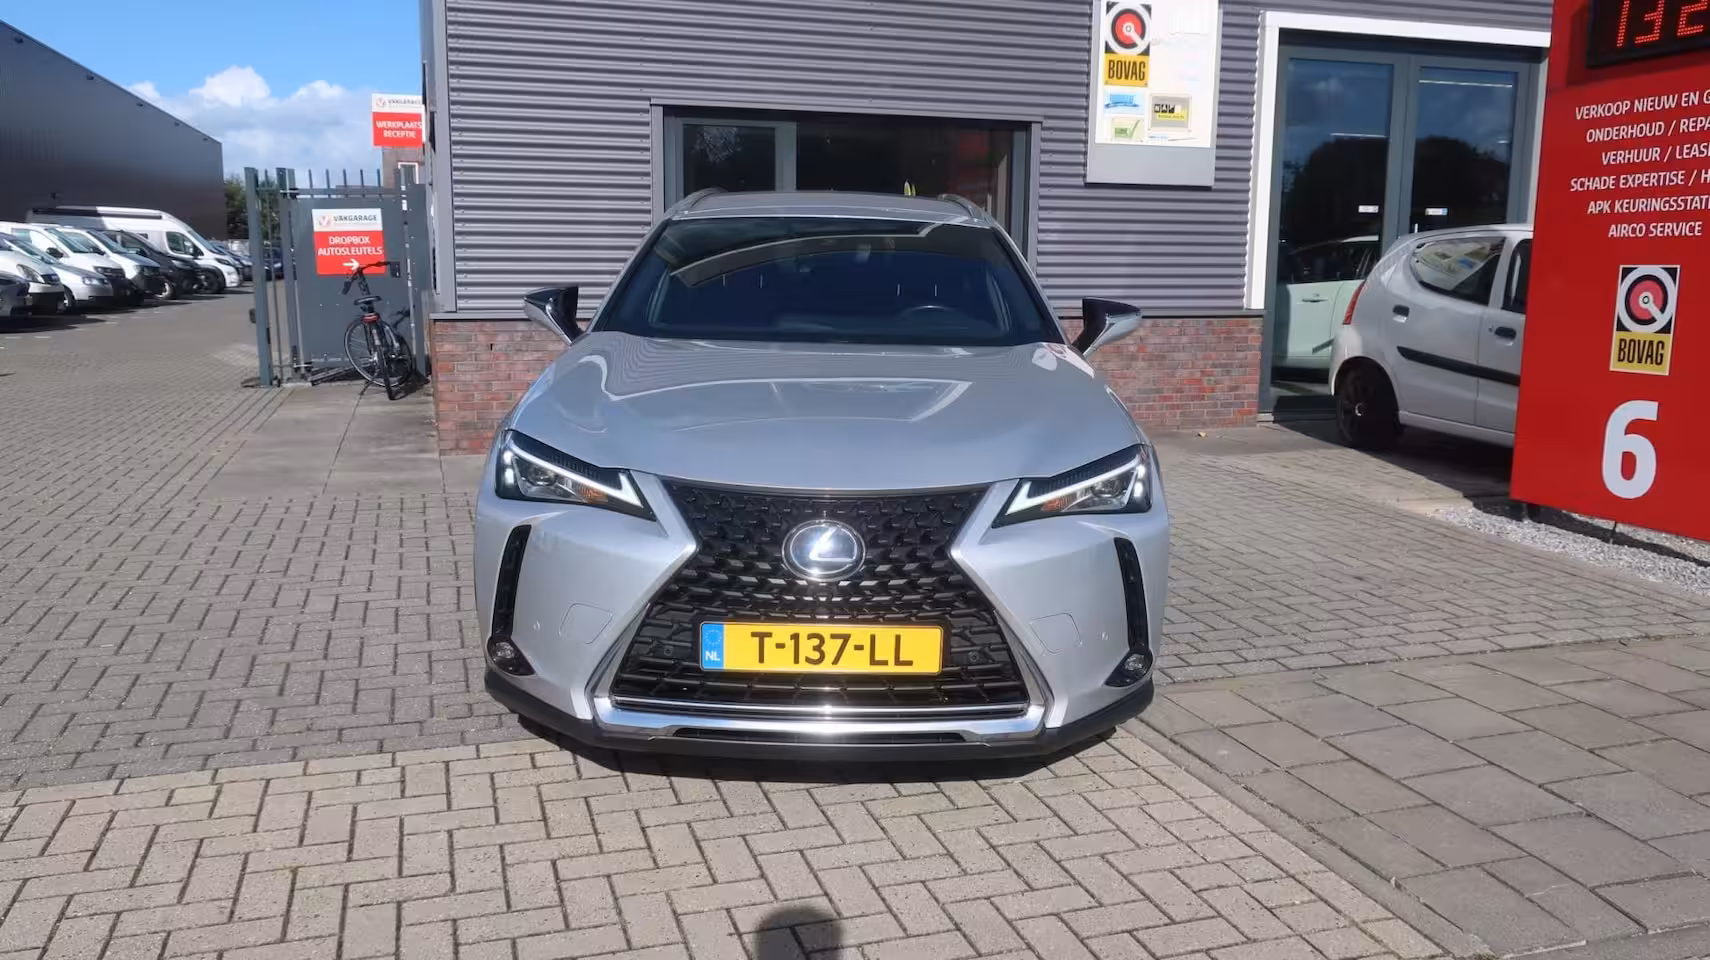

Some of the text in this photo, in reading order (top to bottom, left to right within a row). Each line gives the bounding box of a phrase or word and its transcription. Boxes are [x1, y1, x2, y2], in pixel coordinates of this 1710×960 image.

[1108, 59, 1146, 81] BOVAG
[1575, 100, 1630, 120] VERKOOP
[1634, 94, 1678, 113] NIEUW
[1681, 91, 1699, 107] EN
[376, 120, 422, 129] WERKPLAATS
[383, 129, 416, 138] RECEPTIE
[1586, 121, 1665, 143] ONDERHOUD
[1667, 120, 1676, 137] /
[1601, 147, 1661, 165] VERHUUR
[1664, 146, 1672, 163] /
[1570, 175, 1616, 192] SCHADE
[1619, 170, 1686, 189] EXPERTISE
[1688, 169, 1698, 187] /
[1587, 200, 1612, 215] APK
[333, 214, 377, 222] VAKGARAGE
[1608, 221, 1703, 238] AIRCO SERVICE
[328, 235, 371, 245] DROPBOX
[318, 246, 383, 256] AUTOSLEUTELS
[1617, 338, 1665, 366] BOVAG
[1602, 400, 1660, 499] 6
[705, 631, 914, 667] NL T-137-LL
